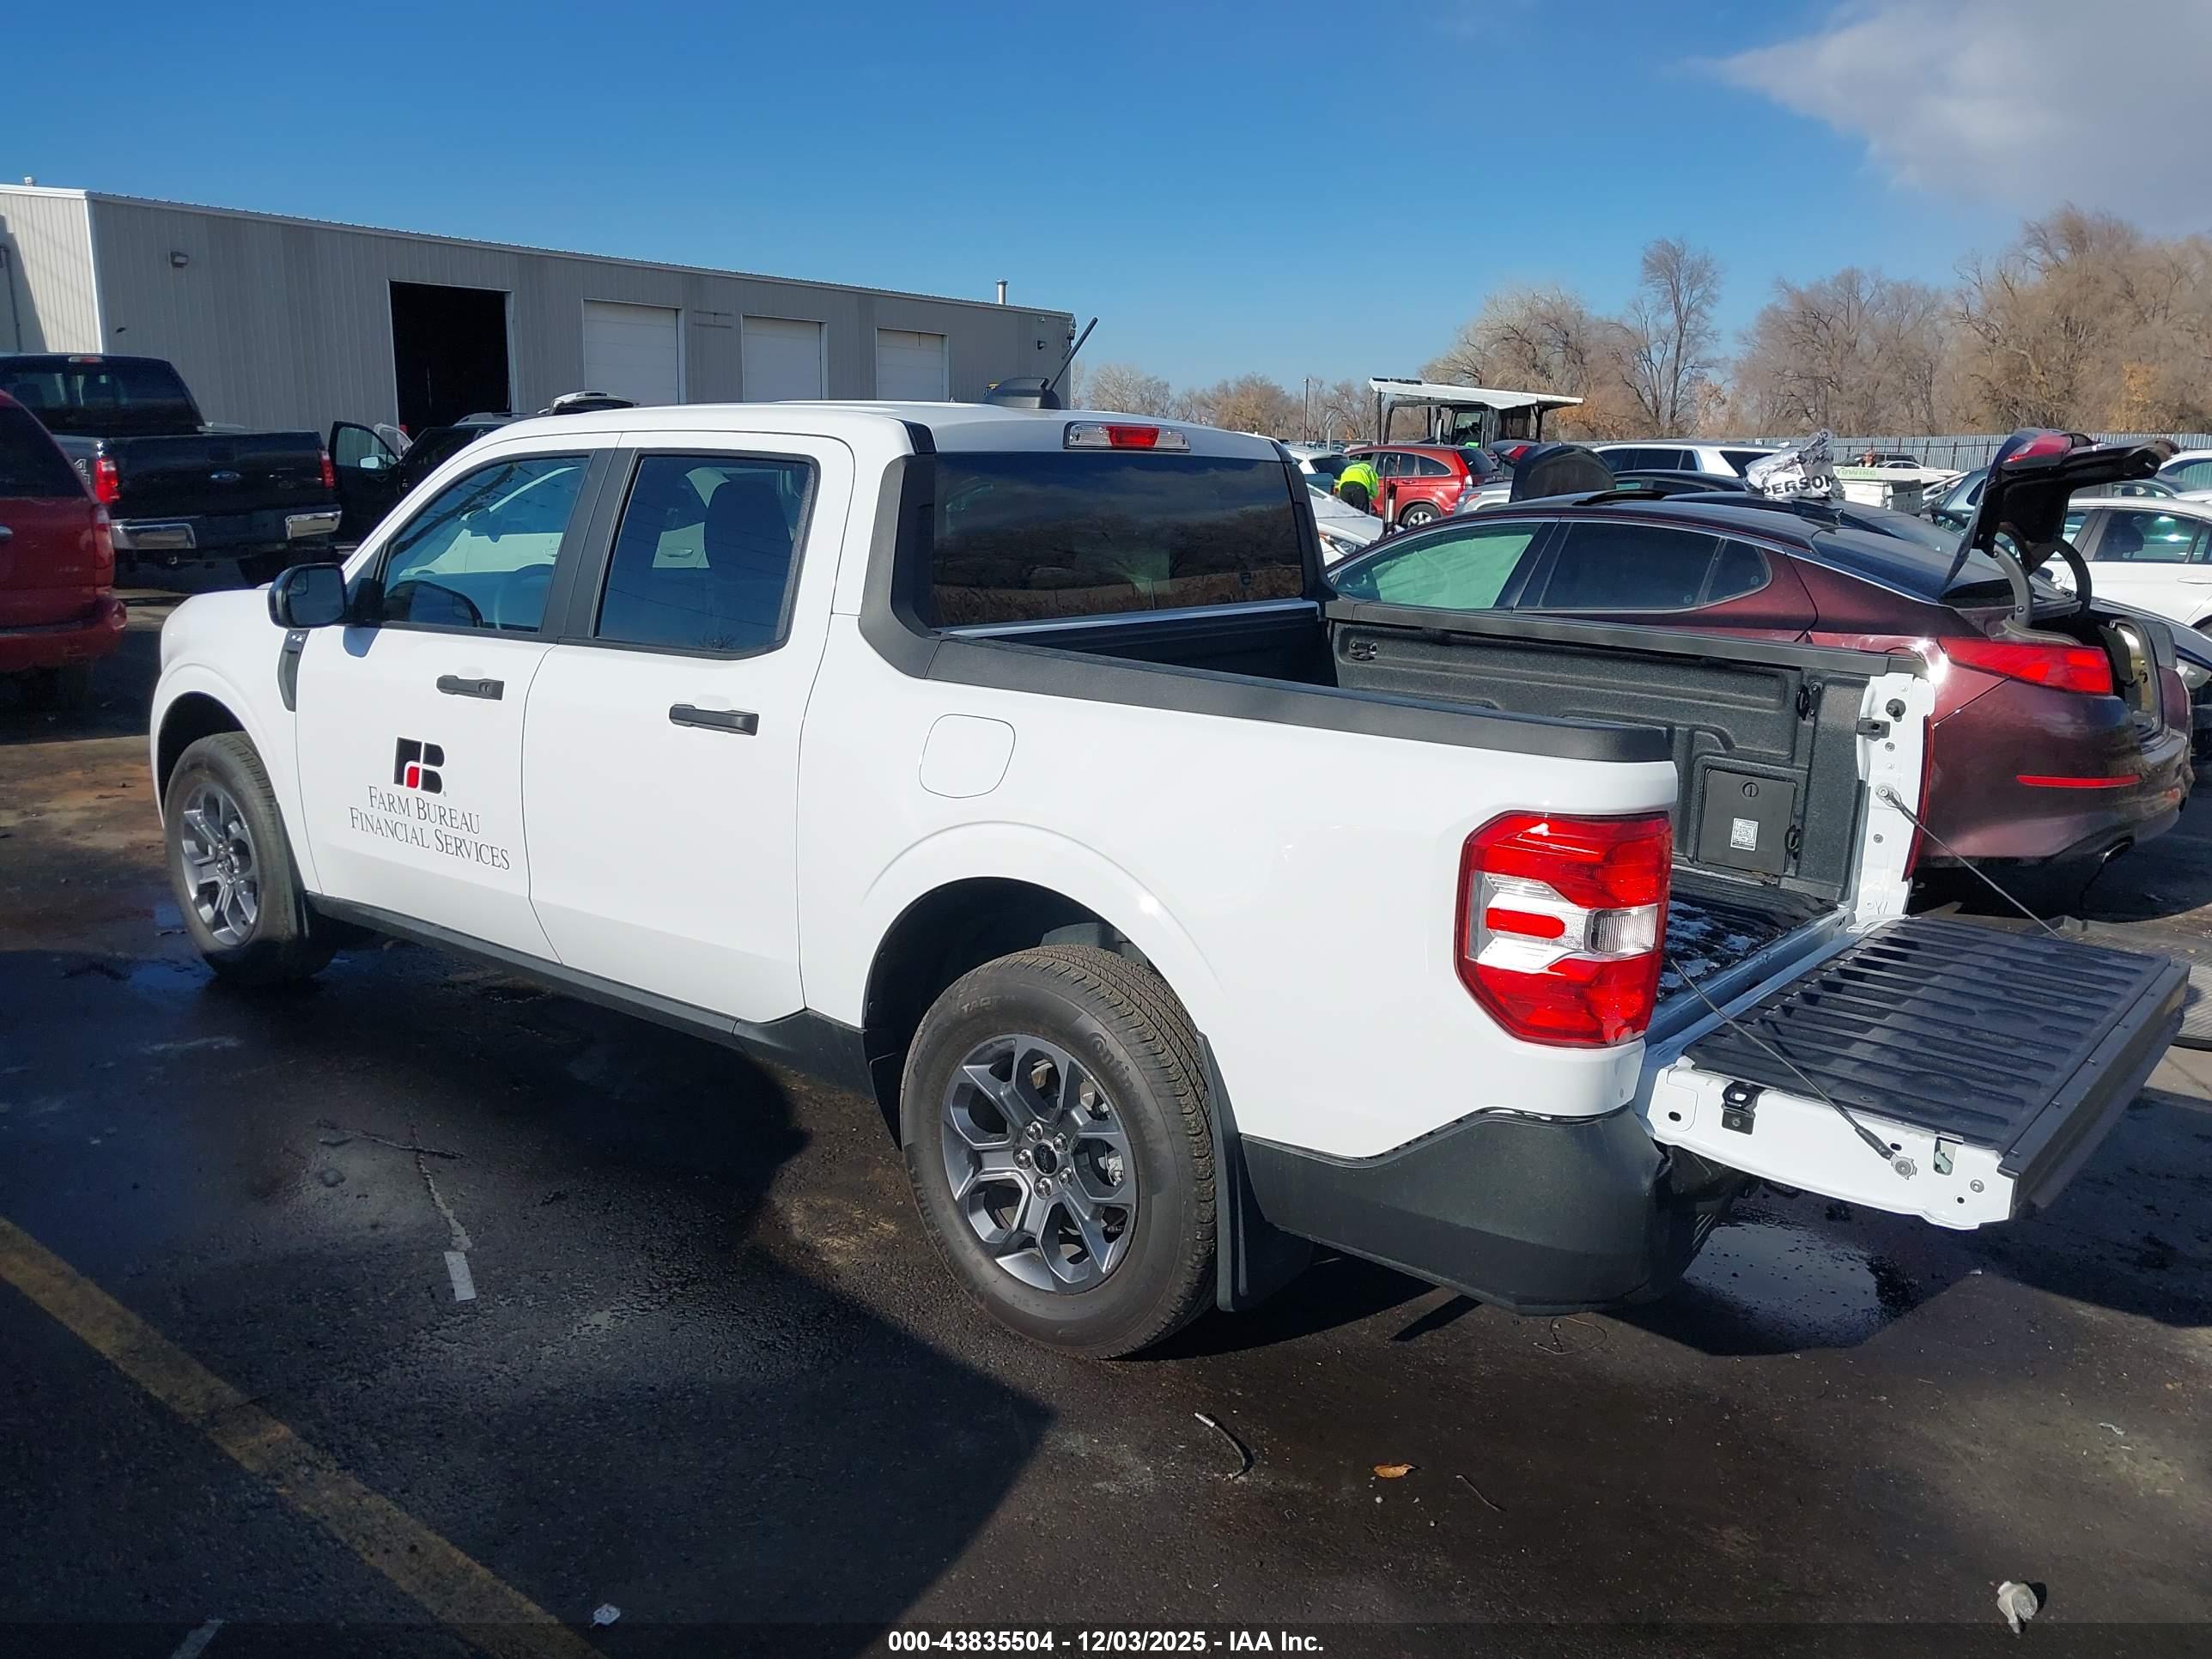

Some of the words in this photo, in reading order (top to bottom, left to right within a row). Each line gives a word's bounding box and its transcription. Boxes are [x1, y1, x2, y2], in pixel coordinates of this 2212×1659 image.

[349, 806, 430, 849] FINANCIAL
[434, 829, 510, 870] SERVICES
[368, 785, 411, 817] FARM
[416, 797, 480, 835] BUREAU
